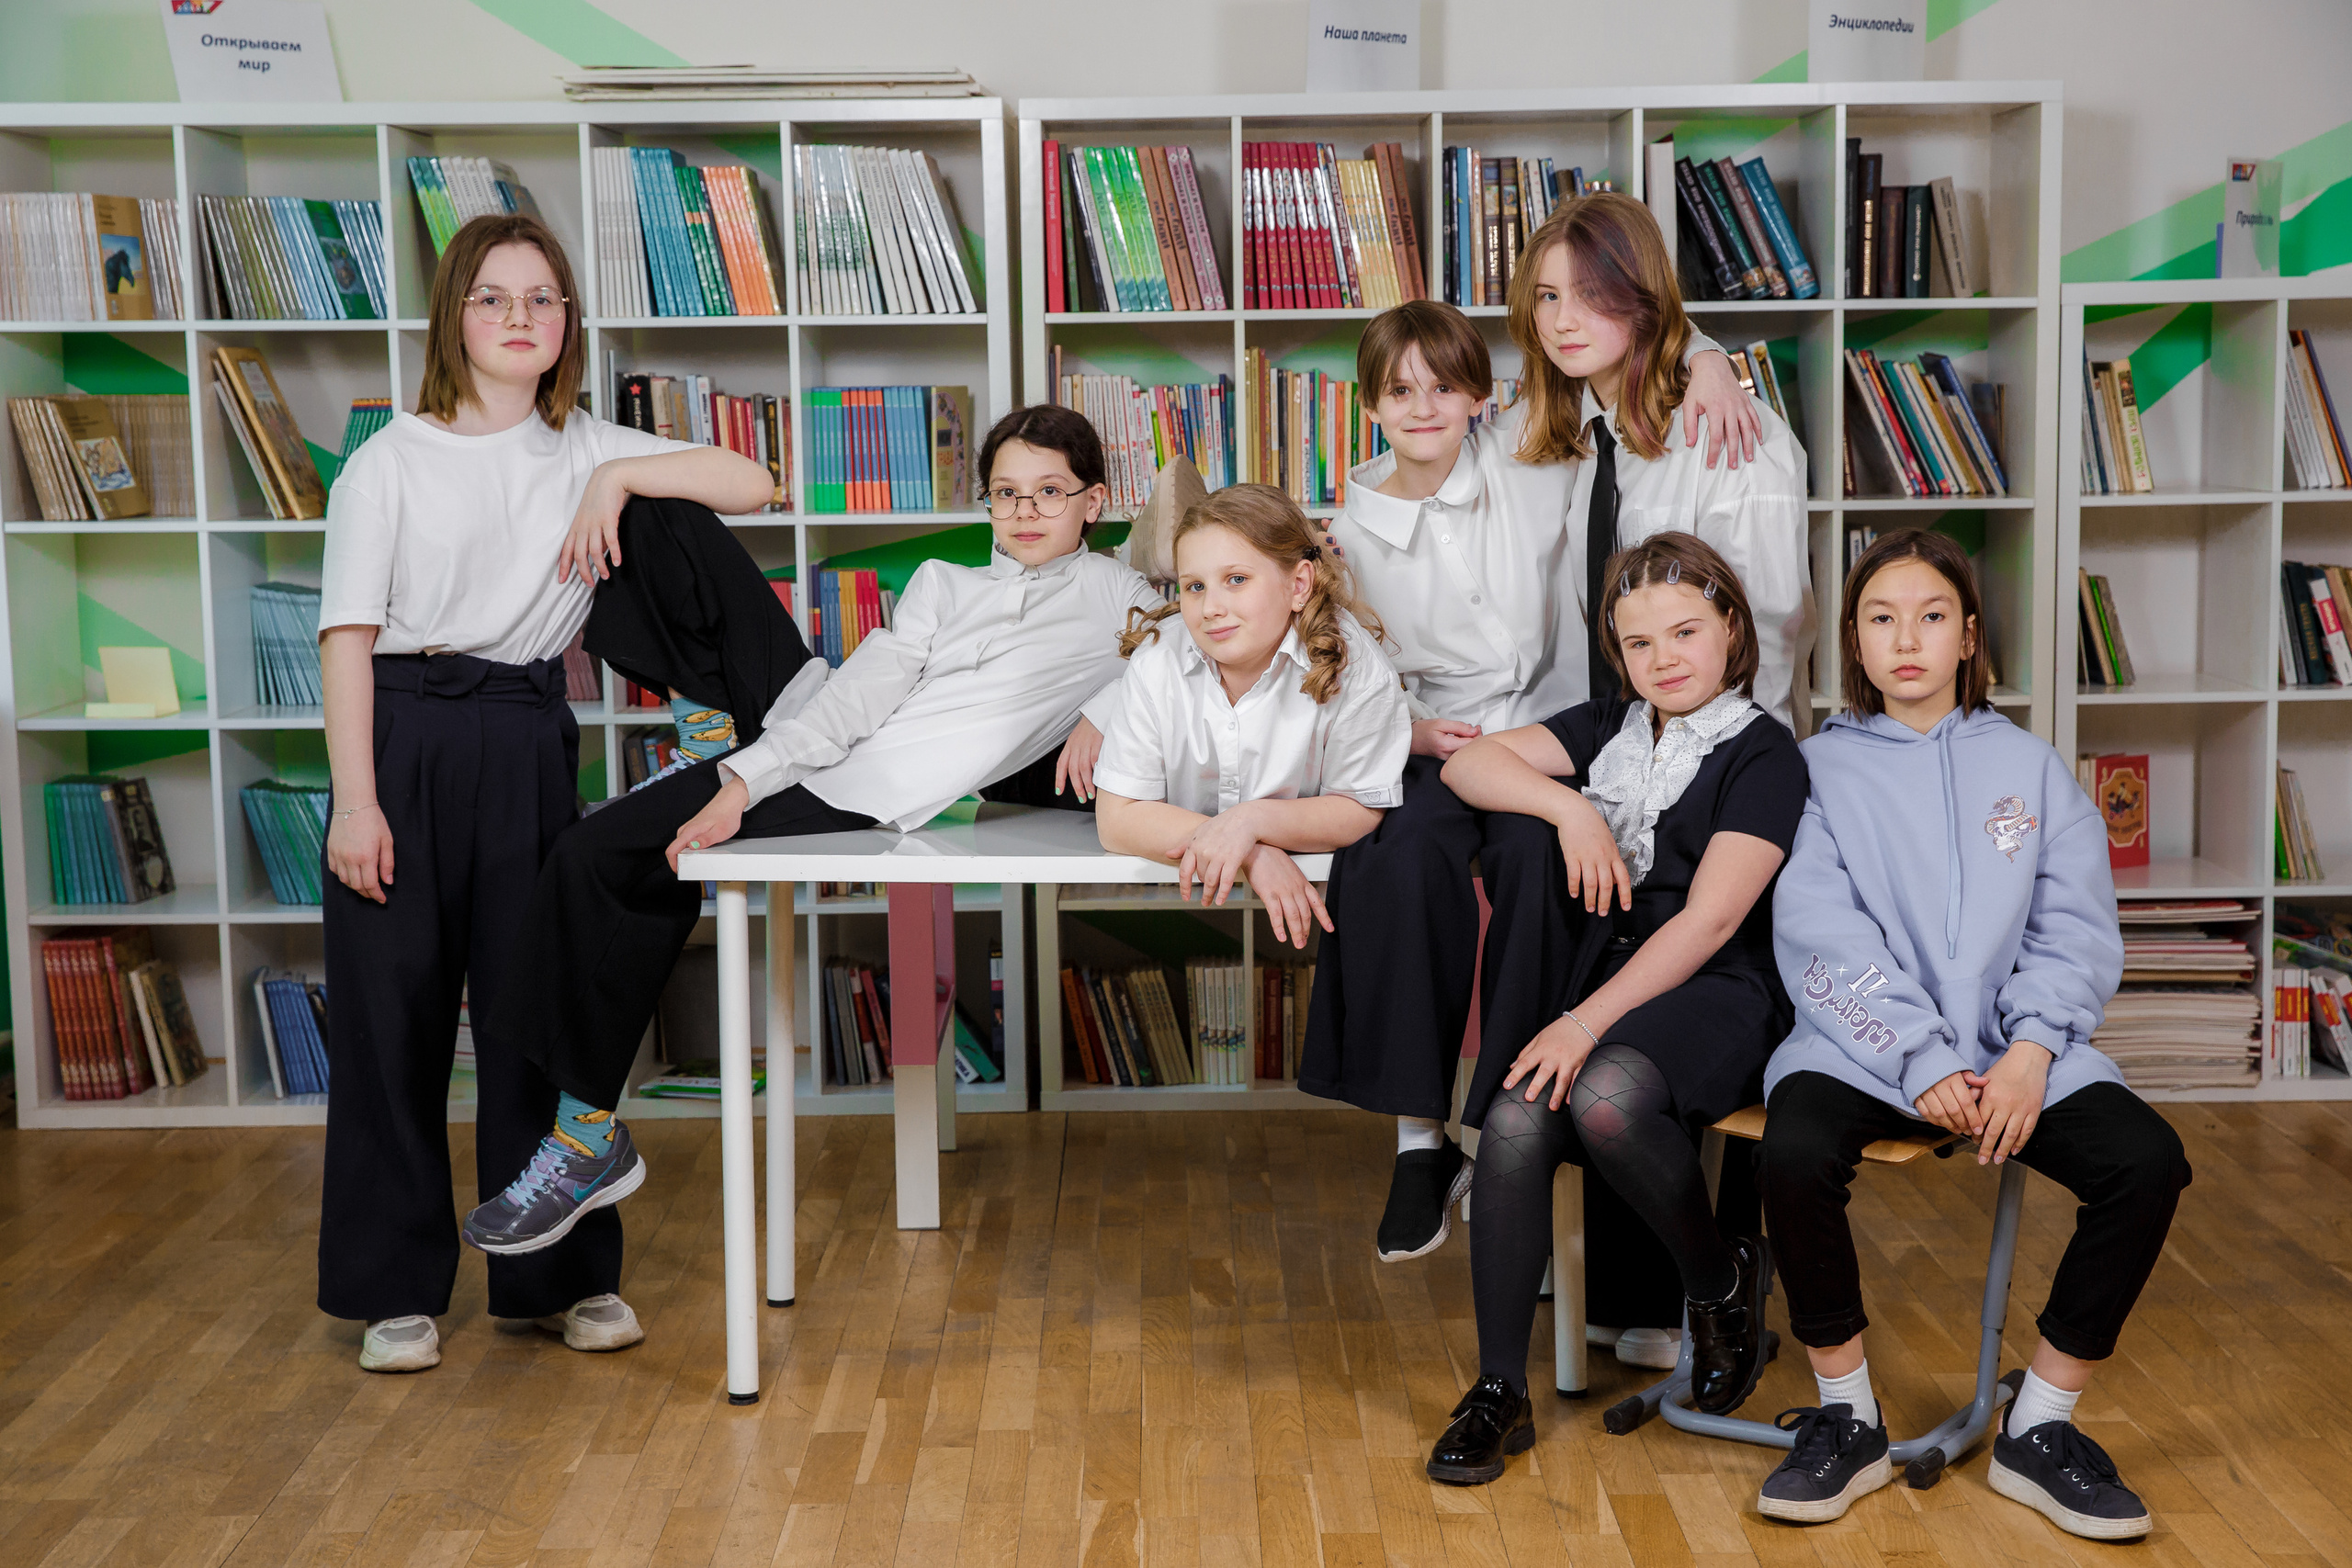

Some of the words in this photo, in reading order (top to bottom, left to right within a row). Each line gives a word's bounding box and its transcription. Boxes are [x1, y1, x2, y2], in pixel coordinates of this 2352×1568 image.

[1828, 14, 1915, 33] Энциклопедии
[201, 34, 301, 52] Открываем
[1324, 25, 1359, 40] Наша
[1362, 30, 1408, 44] планета
[238, 60, 270, 73] мир
